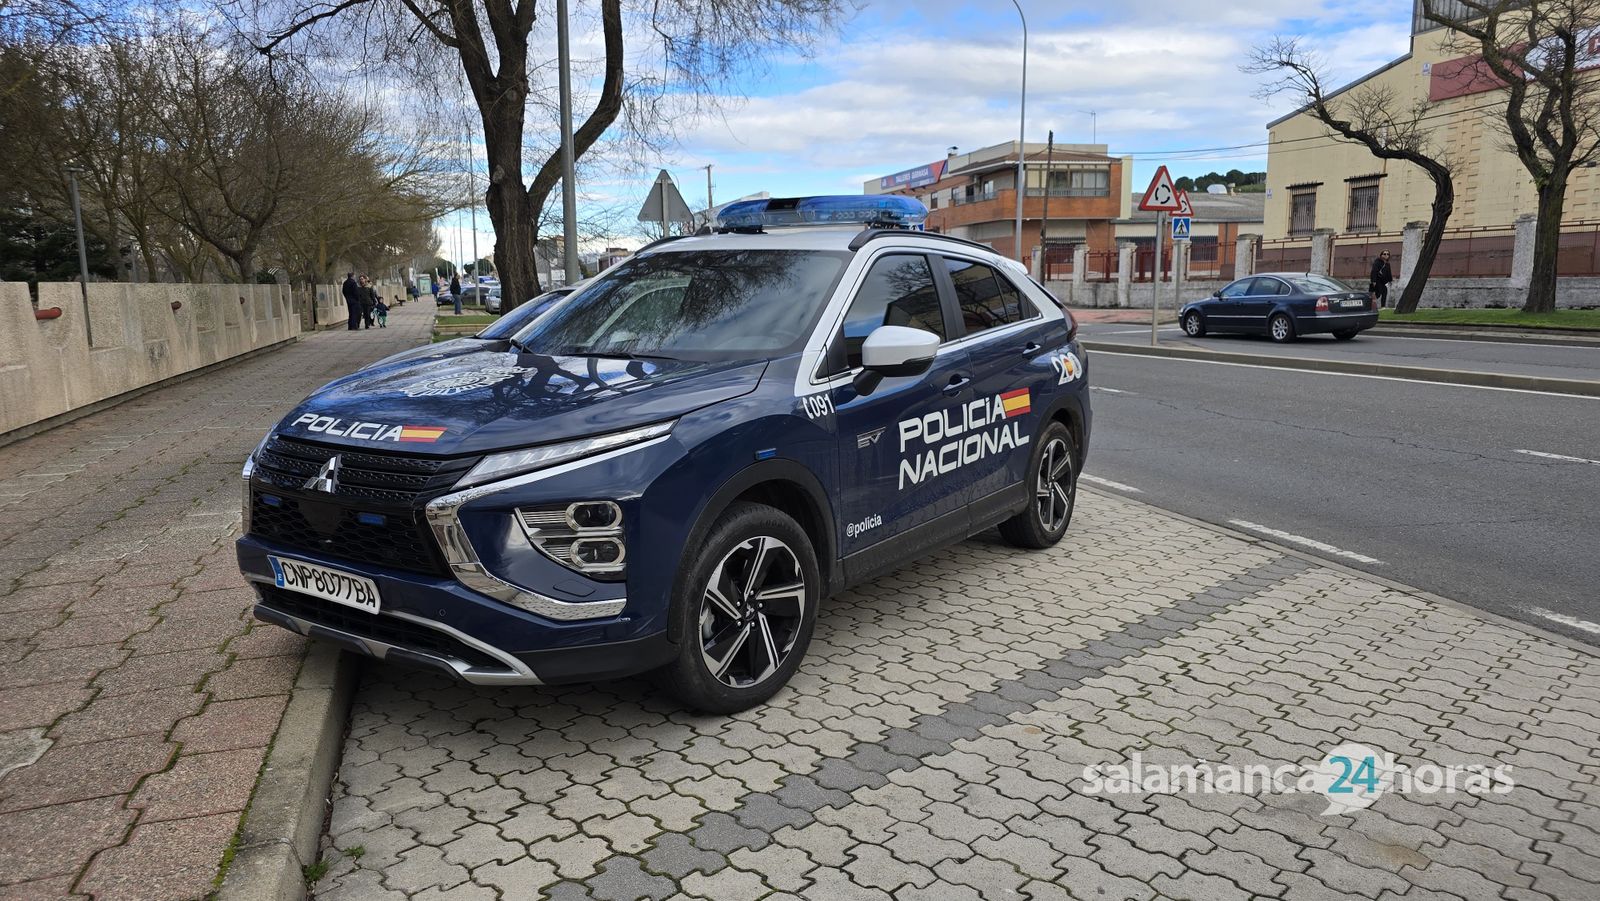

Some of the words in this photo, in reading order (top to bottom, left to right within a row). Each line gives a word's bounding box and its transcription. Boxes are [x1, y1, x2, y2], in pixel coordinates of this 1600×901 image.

[809, 393, 835, 417] 091
[898, 421, 1030, 490] NACIONAL
[281, 561, 376, 608] CNP8077BA
